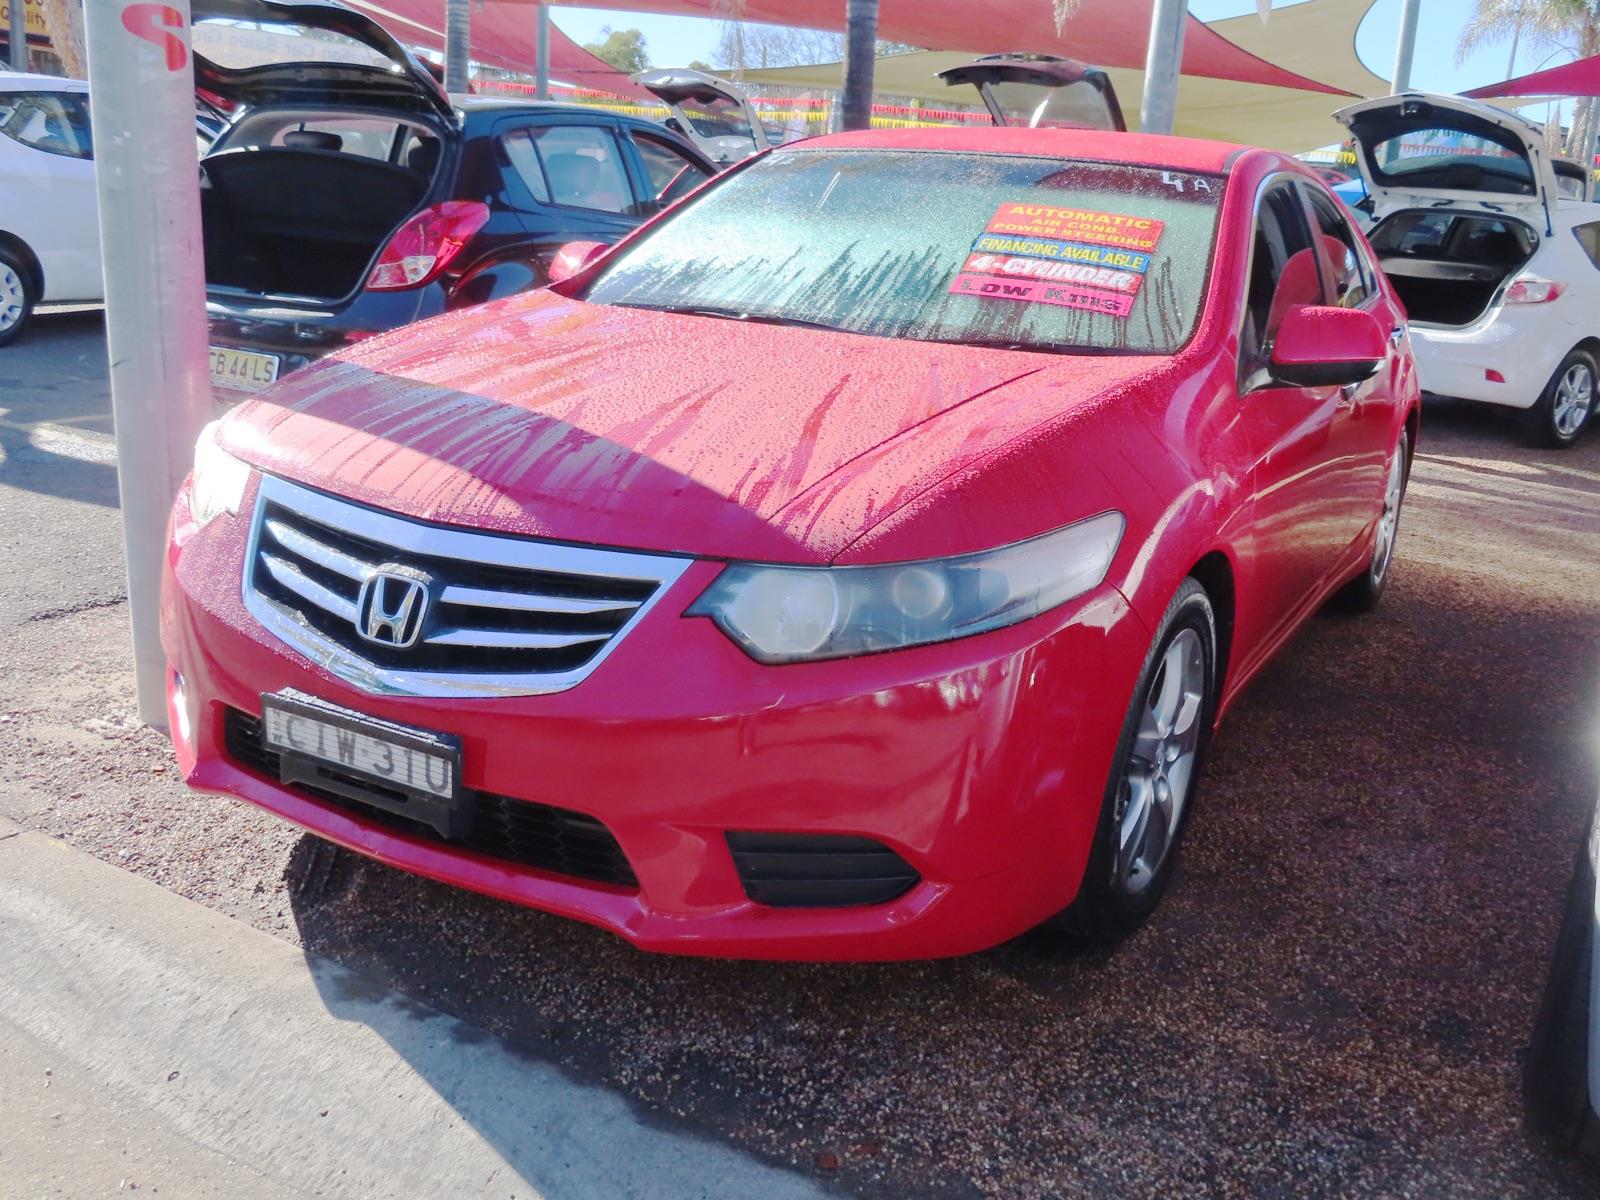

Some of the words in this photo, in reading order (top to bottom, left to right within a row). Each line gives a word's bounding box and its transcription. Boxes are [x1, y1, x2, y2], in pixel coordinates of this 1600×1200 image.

[0, 6, 46, 29] Qlity
[1009, 206, 1151, 230] AUTOMATIC
[1031, 219, 1062, 227] AIR
[993, 223, 1056, 234] POWER
[1061, 229, 1153, 248] STEERING
[978, 238, 1059, 256] FINANCING
[1061, 246, 1144, 269] AVAILABLE
[970, 255, 1132, 289] 4-CYLINDER
